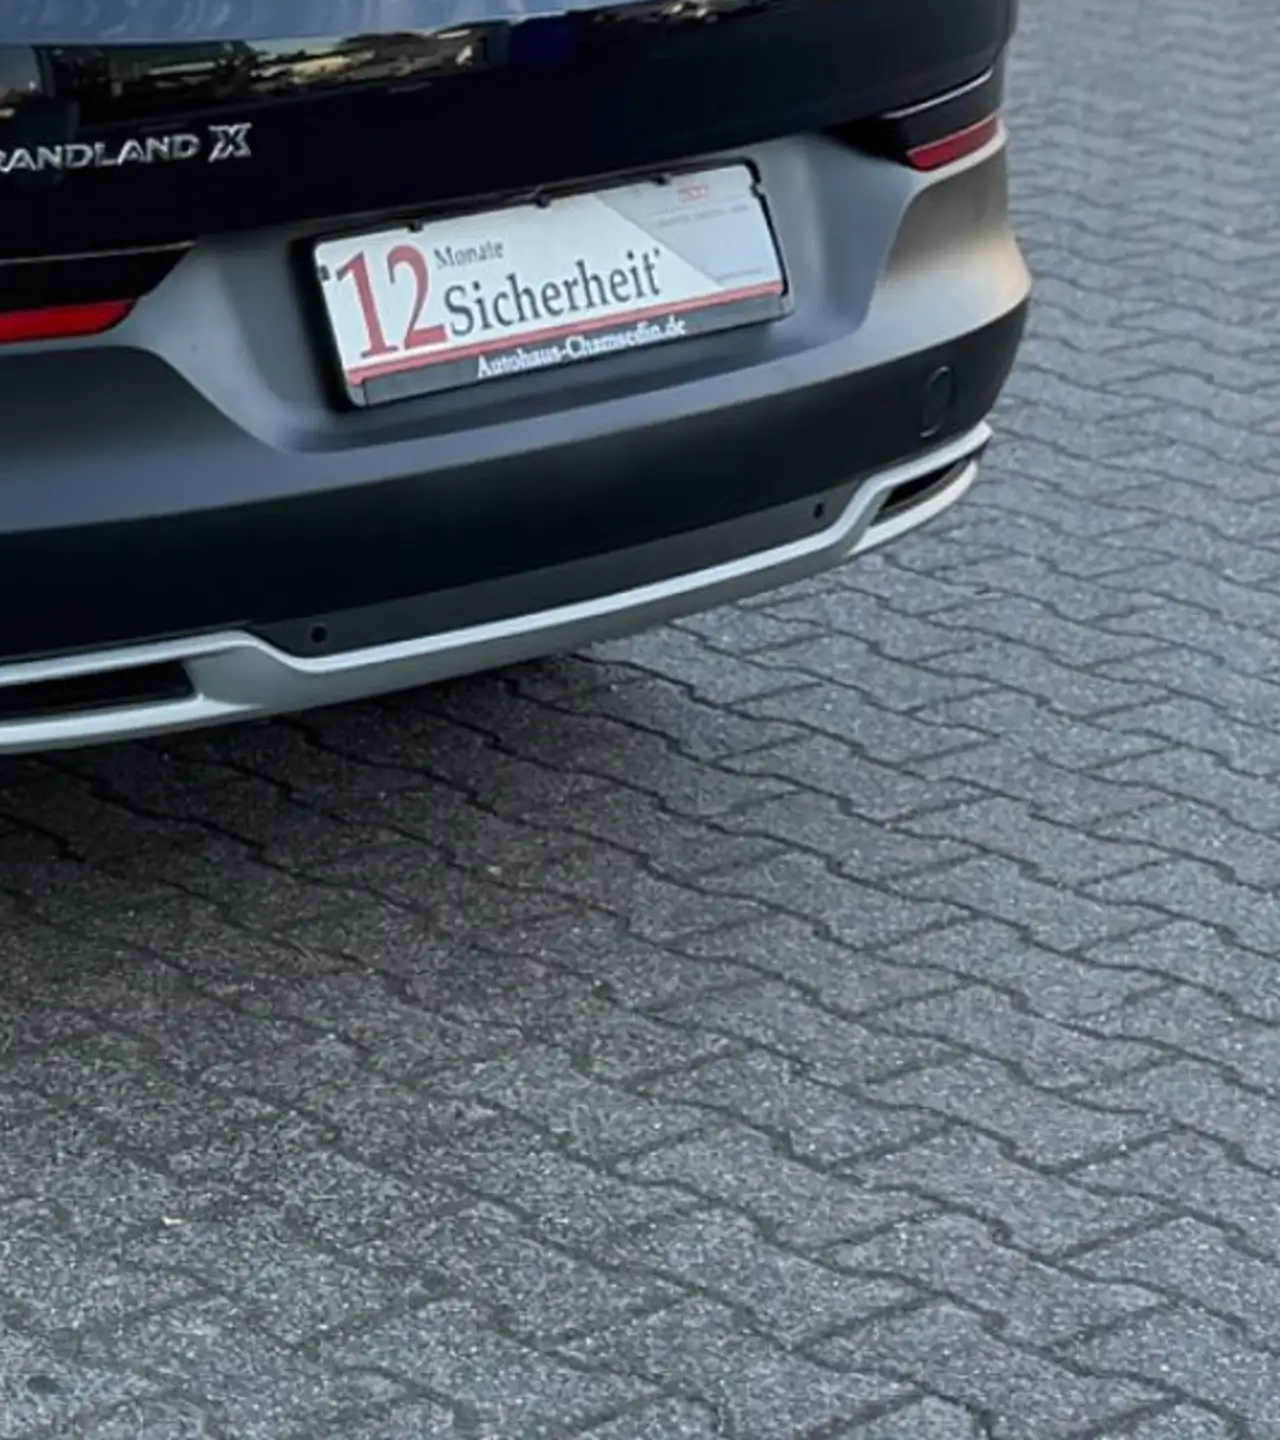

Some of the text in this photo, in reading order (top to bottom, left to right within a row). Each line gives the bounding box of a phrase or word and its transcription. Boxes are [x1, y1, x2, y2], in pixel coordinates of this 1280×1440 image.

[207, 122, 253, 163] X
[336, 238, 504, 359] 12 Monate
